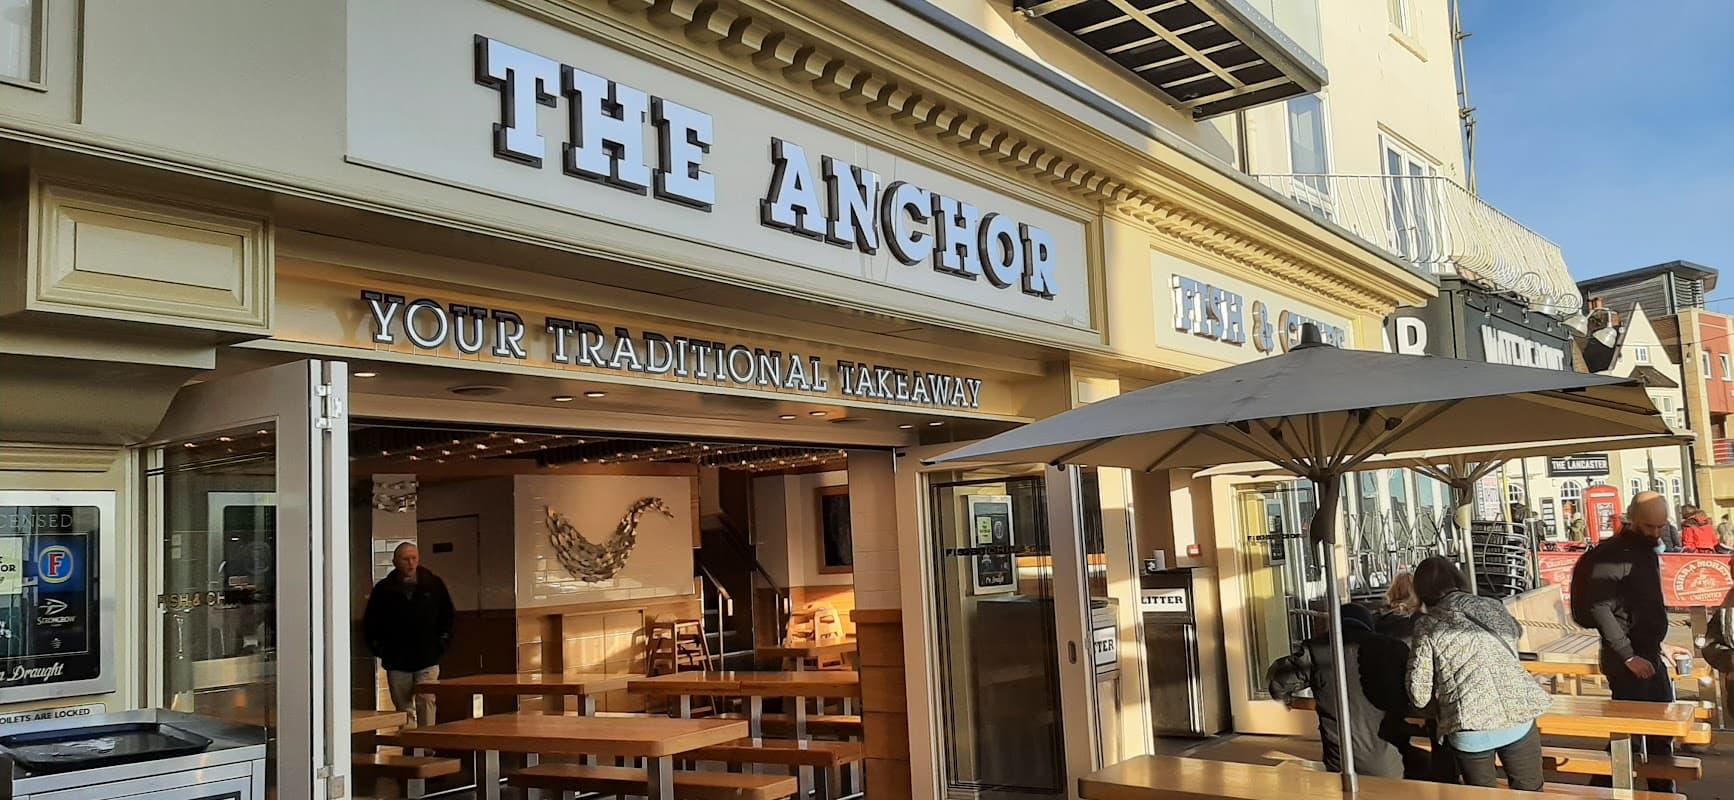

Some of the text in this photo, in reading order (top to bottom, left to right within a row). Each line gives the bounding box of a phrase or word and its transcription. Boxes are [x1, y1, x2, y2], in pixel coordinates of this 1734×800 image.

[474, 33, 1060, 301] THE ANCHOR
[1168, 274, 1246, 347] FISH
[1252, 300, 1274, 354] &
[361, 289, 983, 409] YOUR TRADITIONAL TAKEAWAY
[1552, 459, 1608, 470] THE LANCASTER
[48, 552, 65, 577] F
[1141, 595, 1184, 605] LITTER
[7, 661, 64, 681] Draught
[34, 710, 54, 721] ARE
[54, 707, 91, 718] LOCKED
